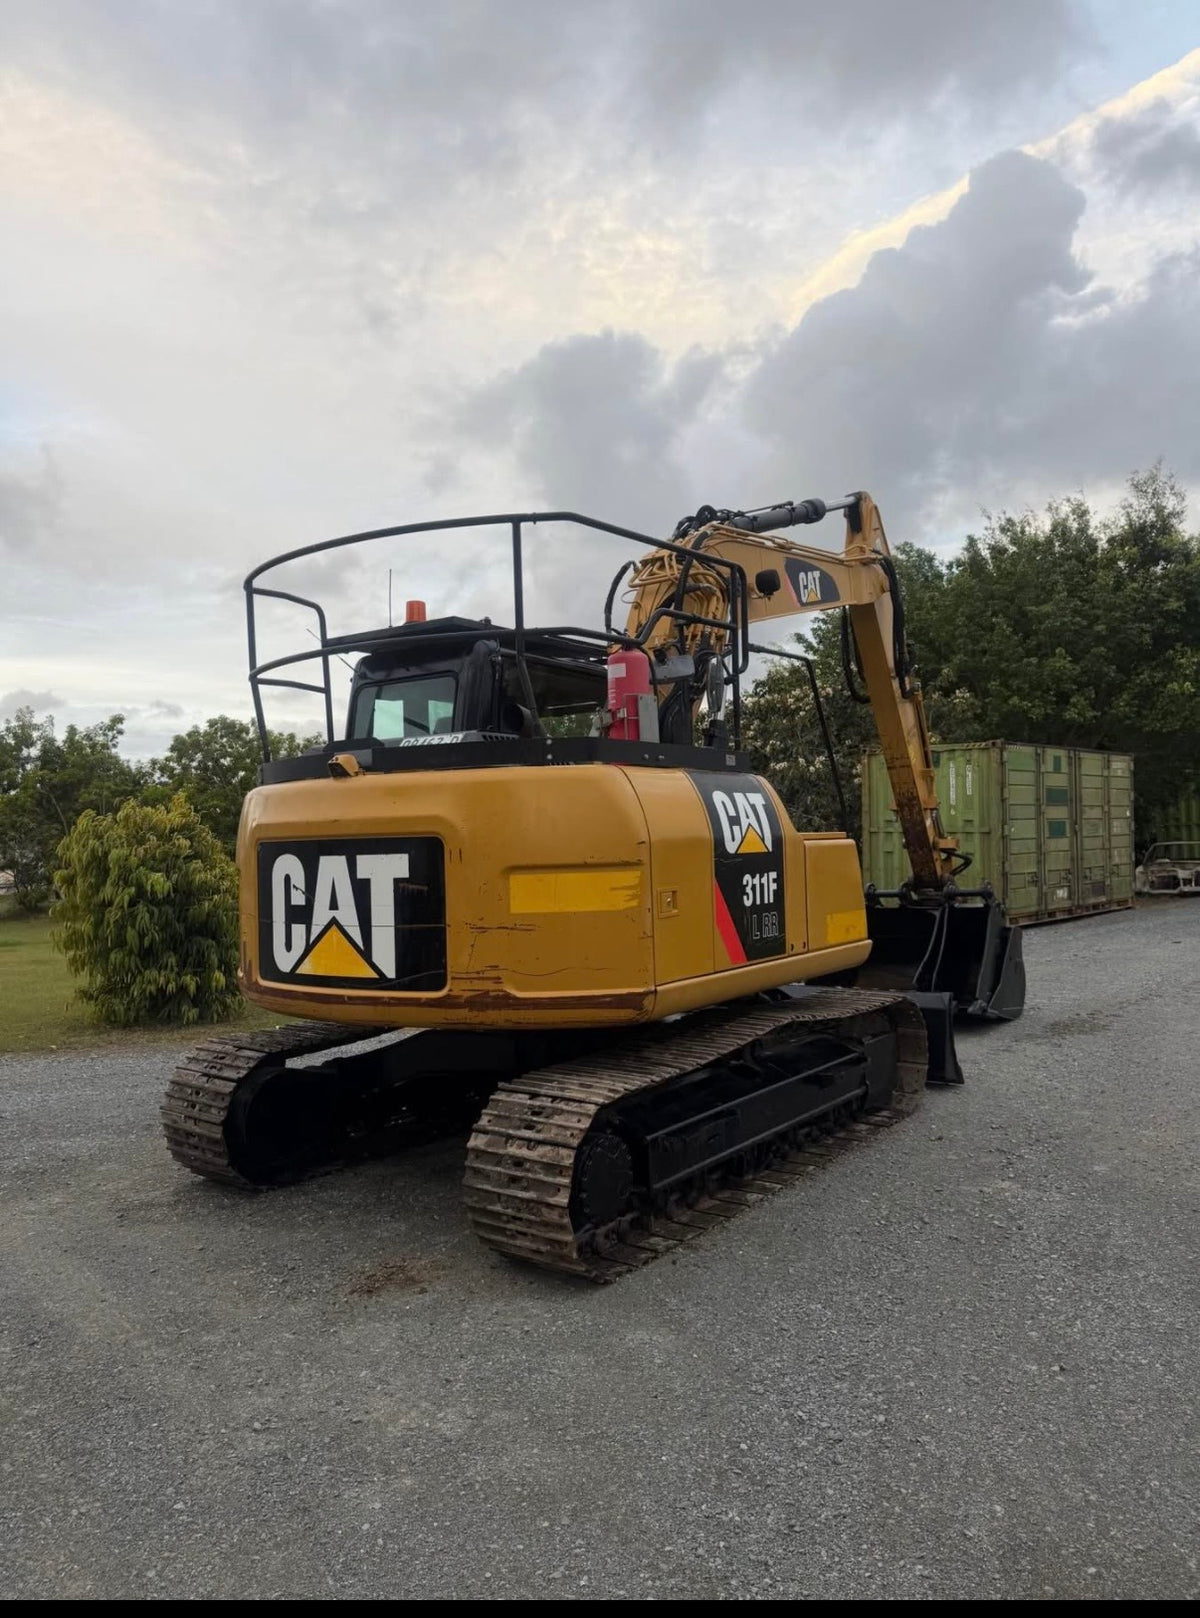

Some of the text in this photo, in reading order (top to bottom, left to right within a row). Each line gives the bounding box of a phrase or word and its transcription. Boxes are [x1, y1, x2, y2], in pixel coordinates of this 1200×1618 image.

[799, 570, 821, 604] CAT
[712, 790, 772, 854] CAT
[742, 871, 777, 907] 311F
[271, 853, 410, 979] CAT
[752, 911, 779, 940] L RR
